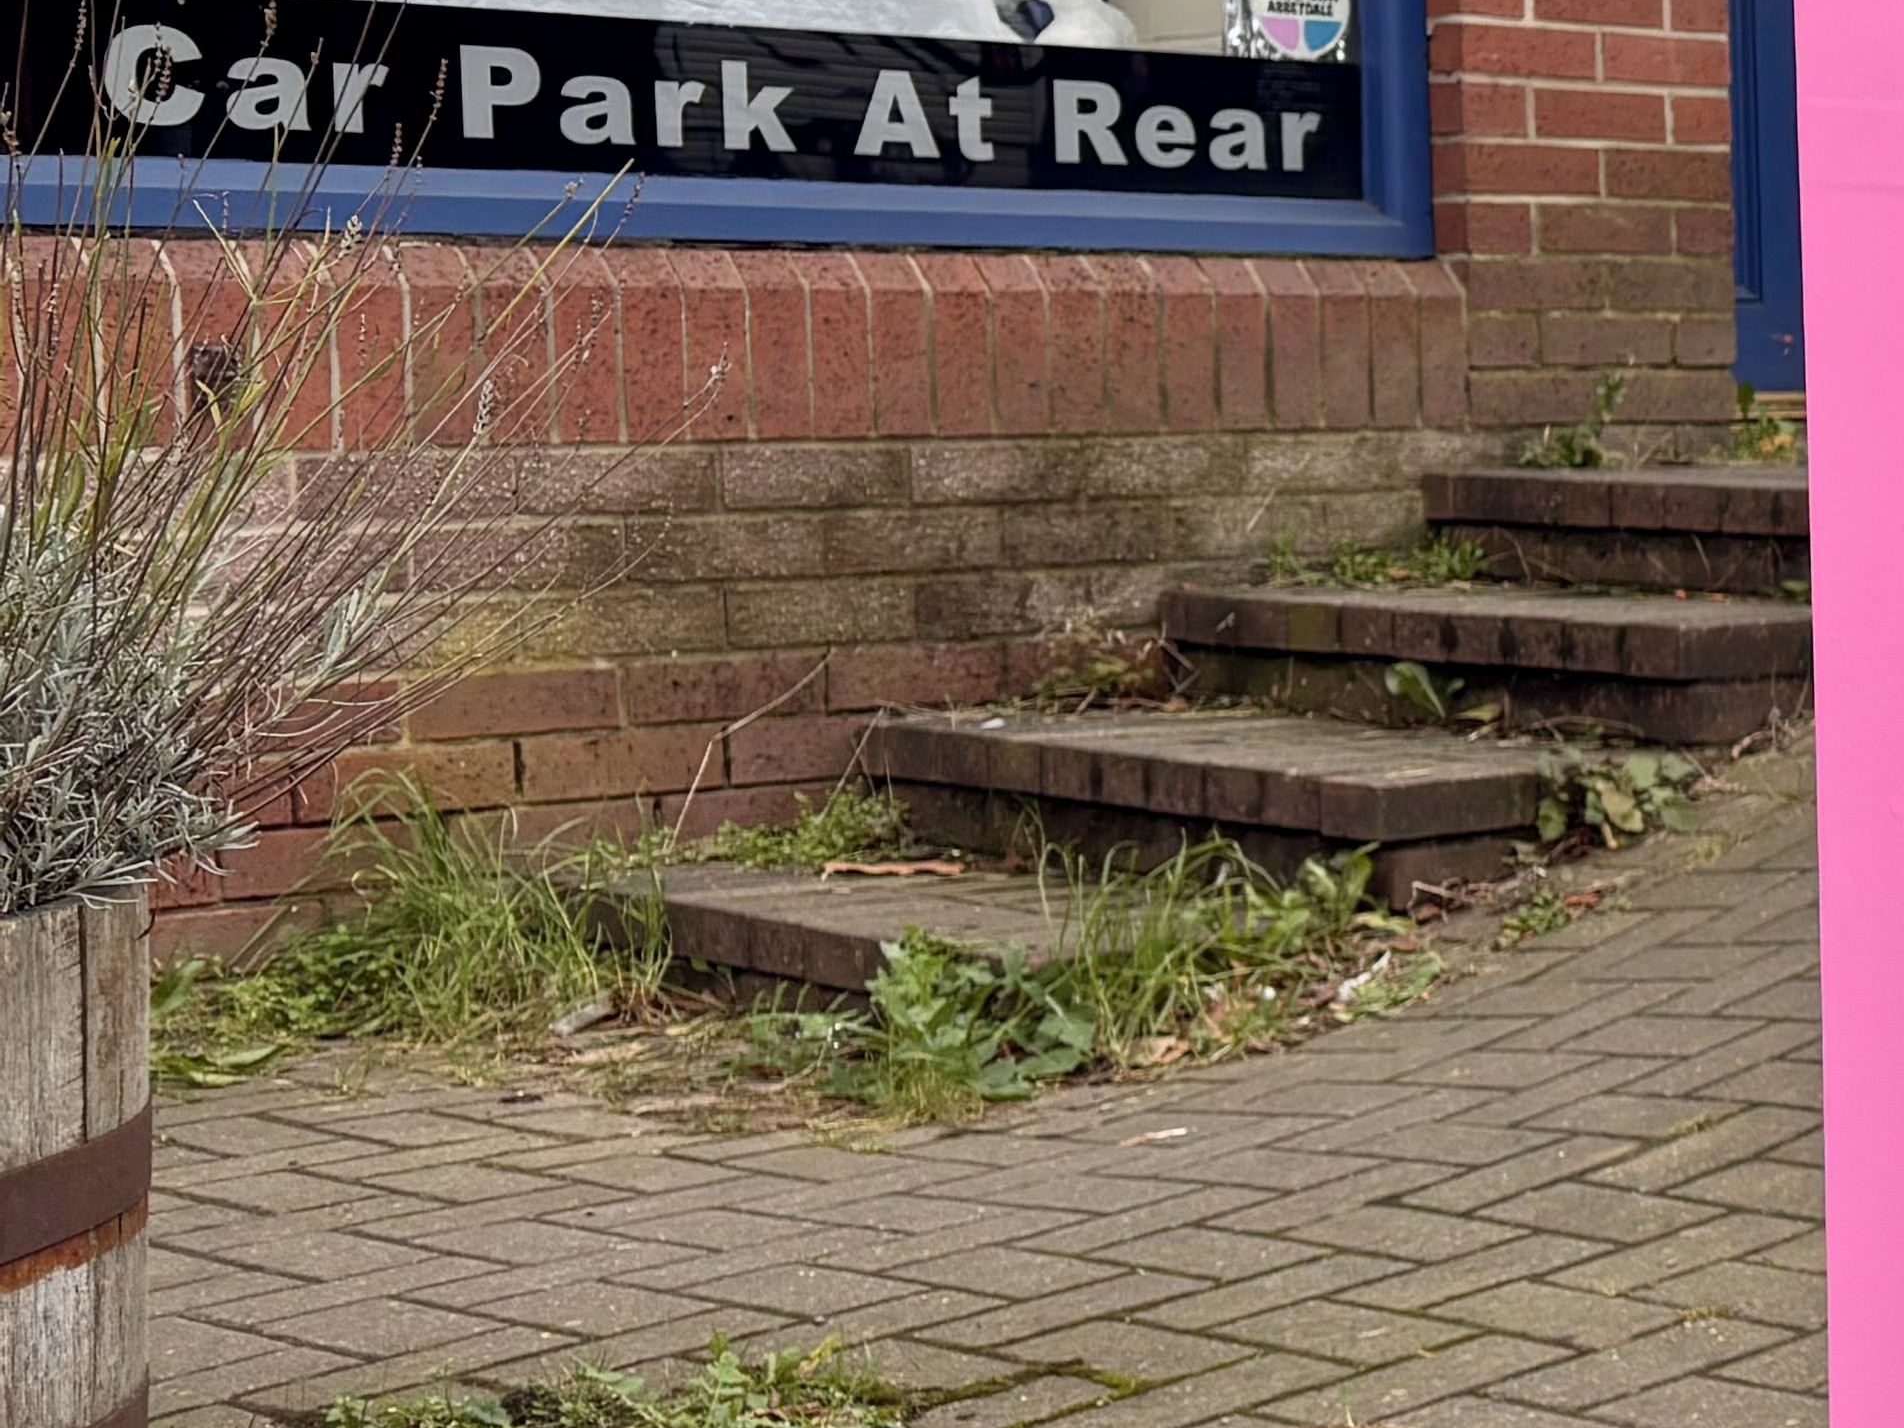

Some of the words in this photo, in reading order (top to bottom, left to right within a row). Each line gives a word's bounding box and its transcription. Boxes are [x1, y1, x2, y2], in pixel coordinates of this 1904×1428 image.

[105, 24, 389, 134] Car
[460, 44, 796, 152] Park
[853, 69, 995, 162] At
[1053, 79, 1322, 172] Rear
